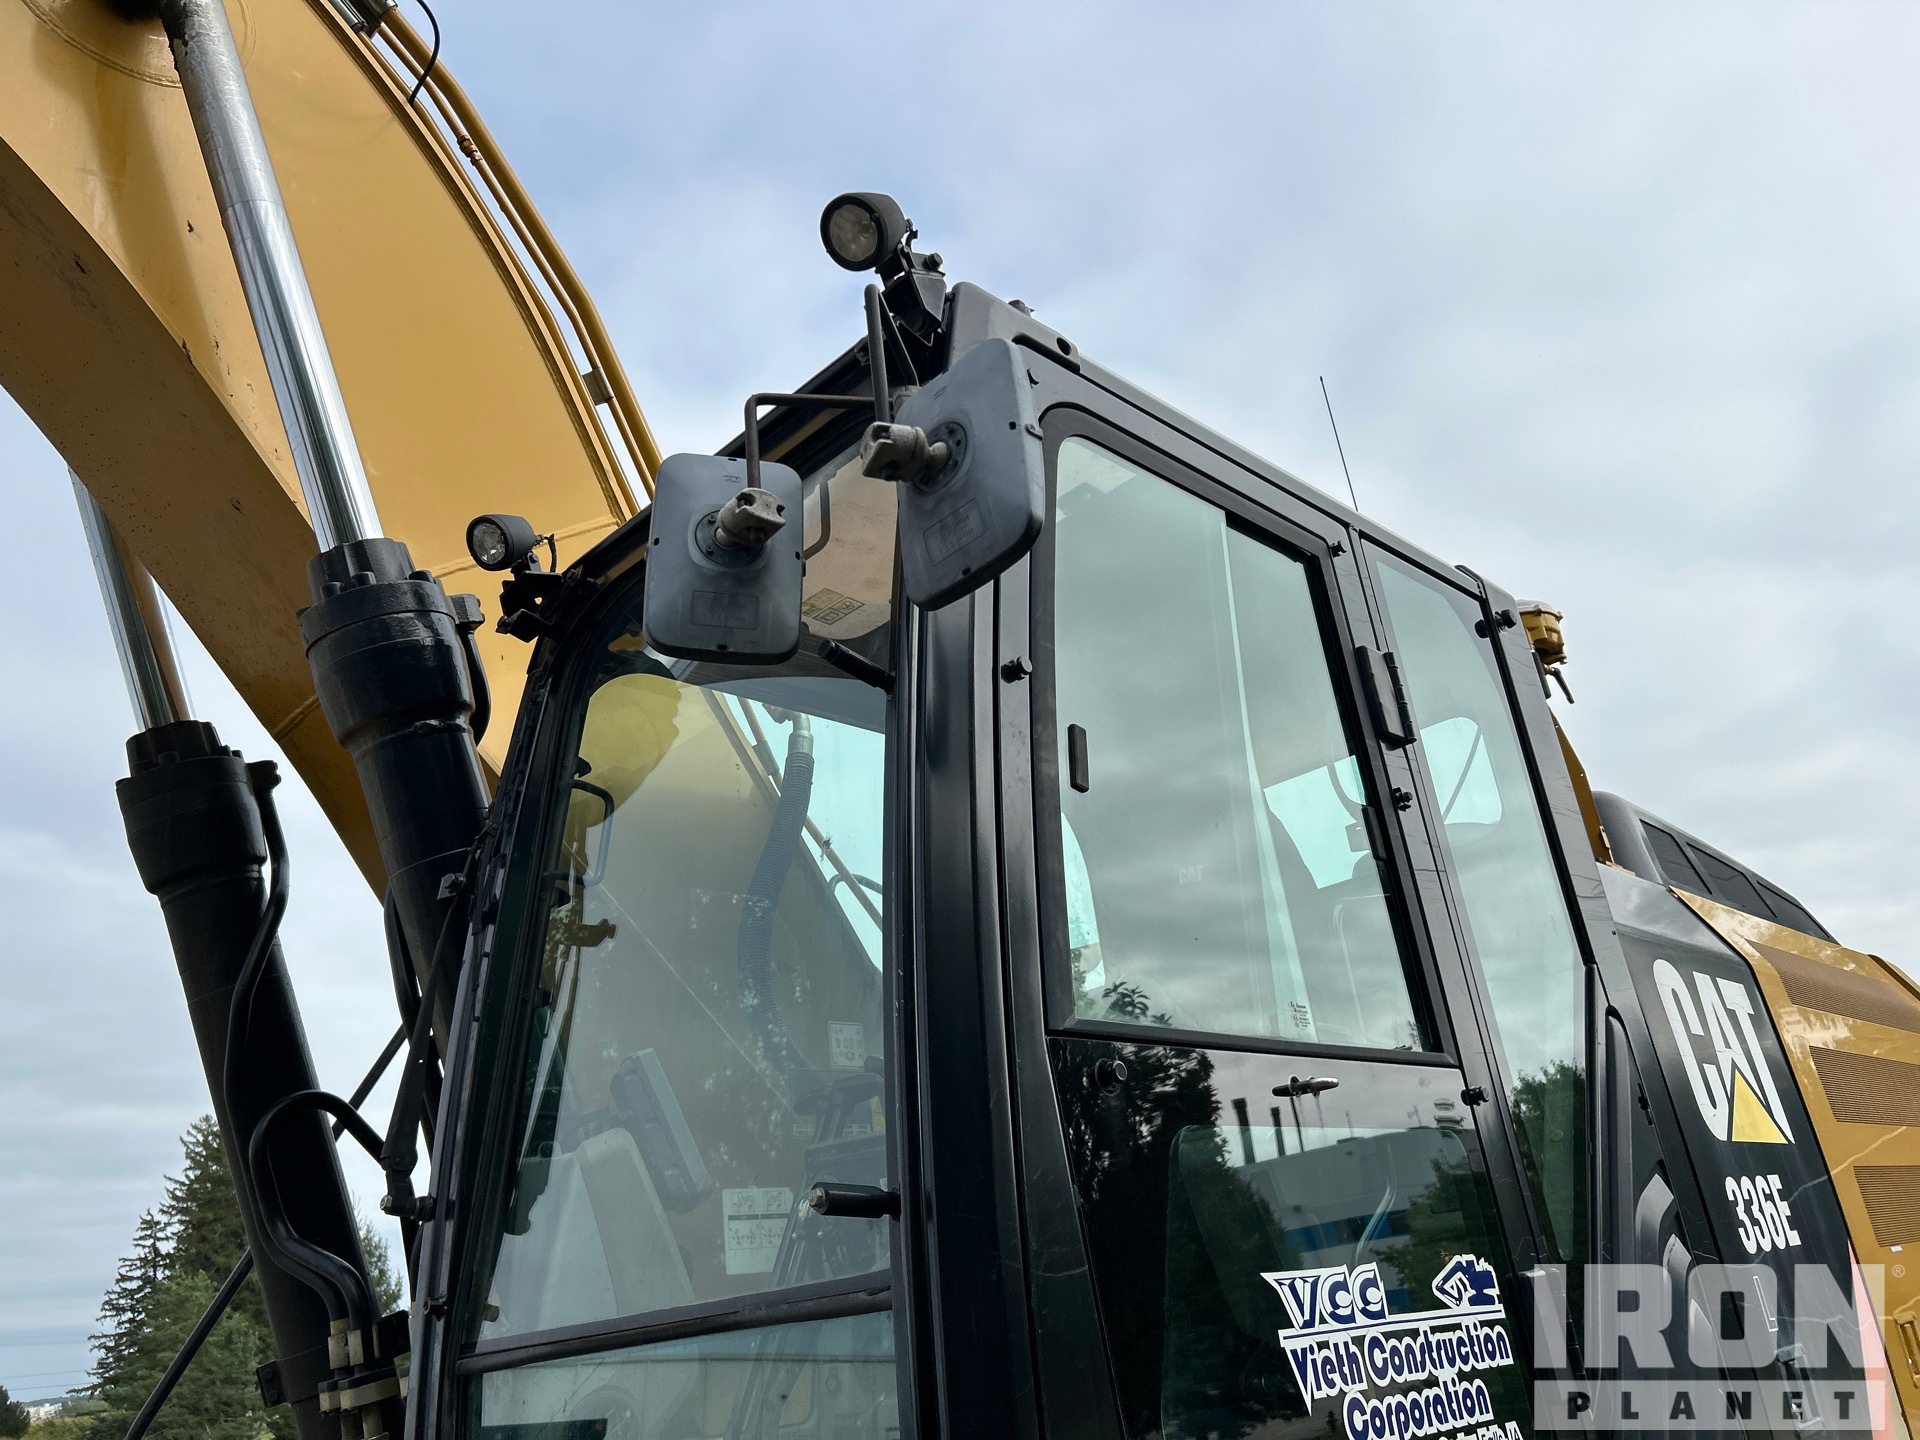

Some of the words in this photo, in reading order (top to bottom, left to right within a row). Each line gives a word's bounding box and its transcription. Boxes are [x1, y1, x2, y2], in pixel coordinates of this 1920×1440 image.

[1653, 959, 1796, 1144] CAT
[1725, 1174, 1802, 1254] 336E
[1268, 1266, 1388, 1330] VCC
[1289, 1340, 1366, 1403] Vieth
[1367, 1321, 1510, 1381] Construction
[1346, 1374, 1491, 1440] Corporation
